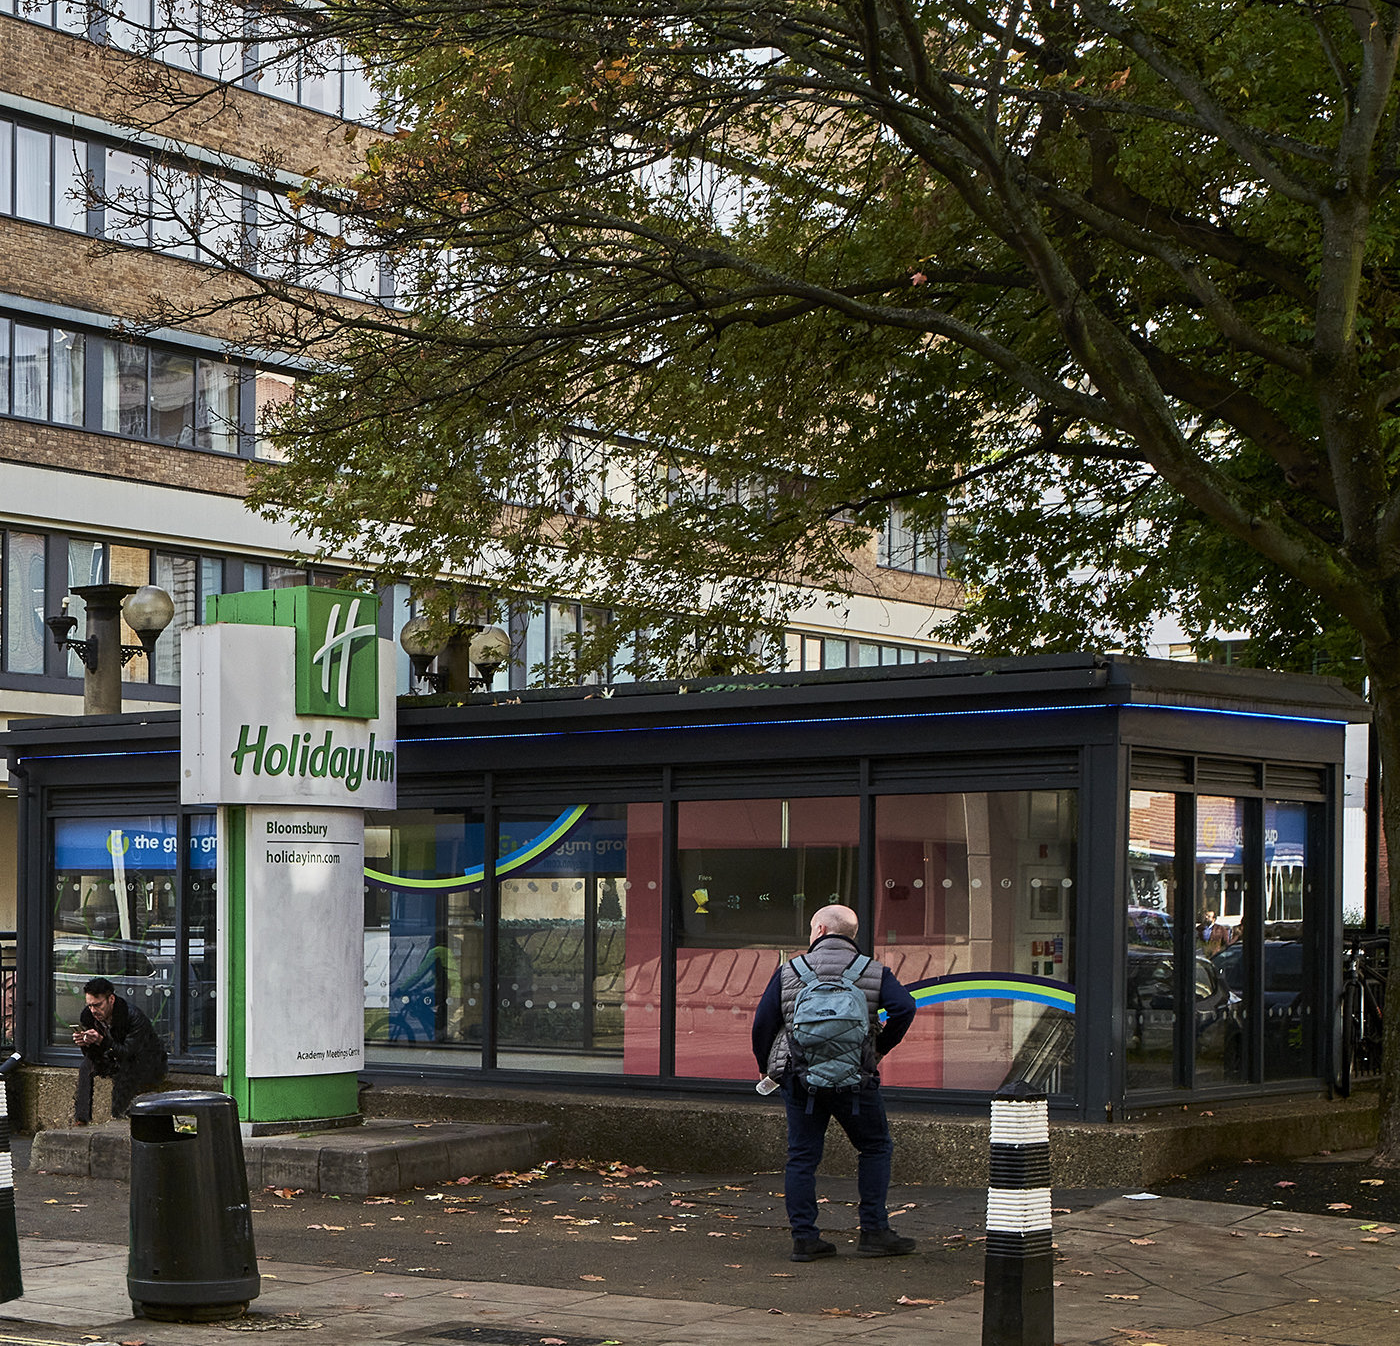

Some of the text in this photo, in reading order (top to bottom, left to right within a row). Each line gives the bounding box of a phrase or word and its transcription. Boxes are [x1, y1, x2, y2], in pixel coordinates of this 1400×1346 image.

[231, 725, 395, 791] Holiday Inn
[266, 820, 328, 838] Bloomsbury
[134, 834, 160, 849] the
[266, 850, 341, 866] holidayinn.com
[297, 1050, 325, 1060] Academy
[326, 1049, 348, 1059] Meetings
